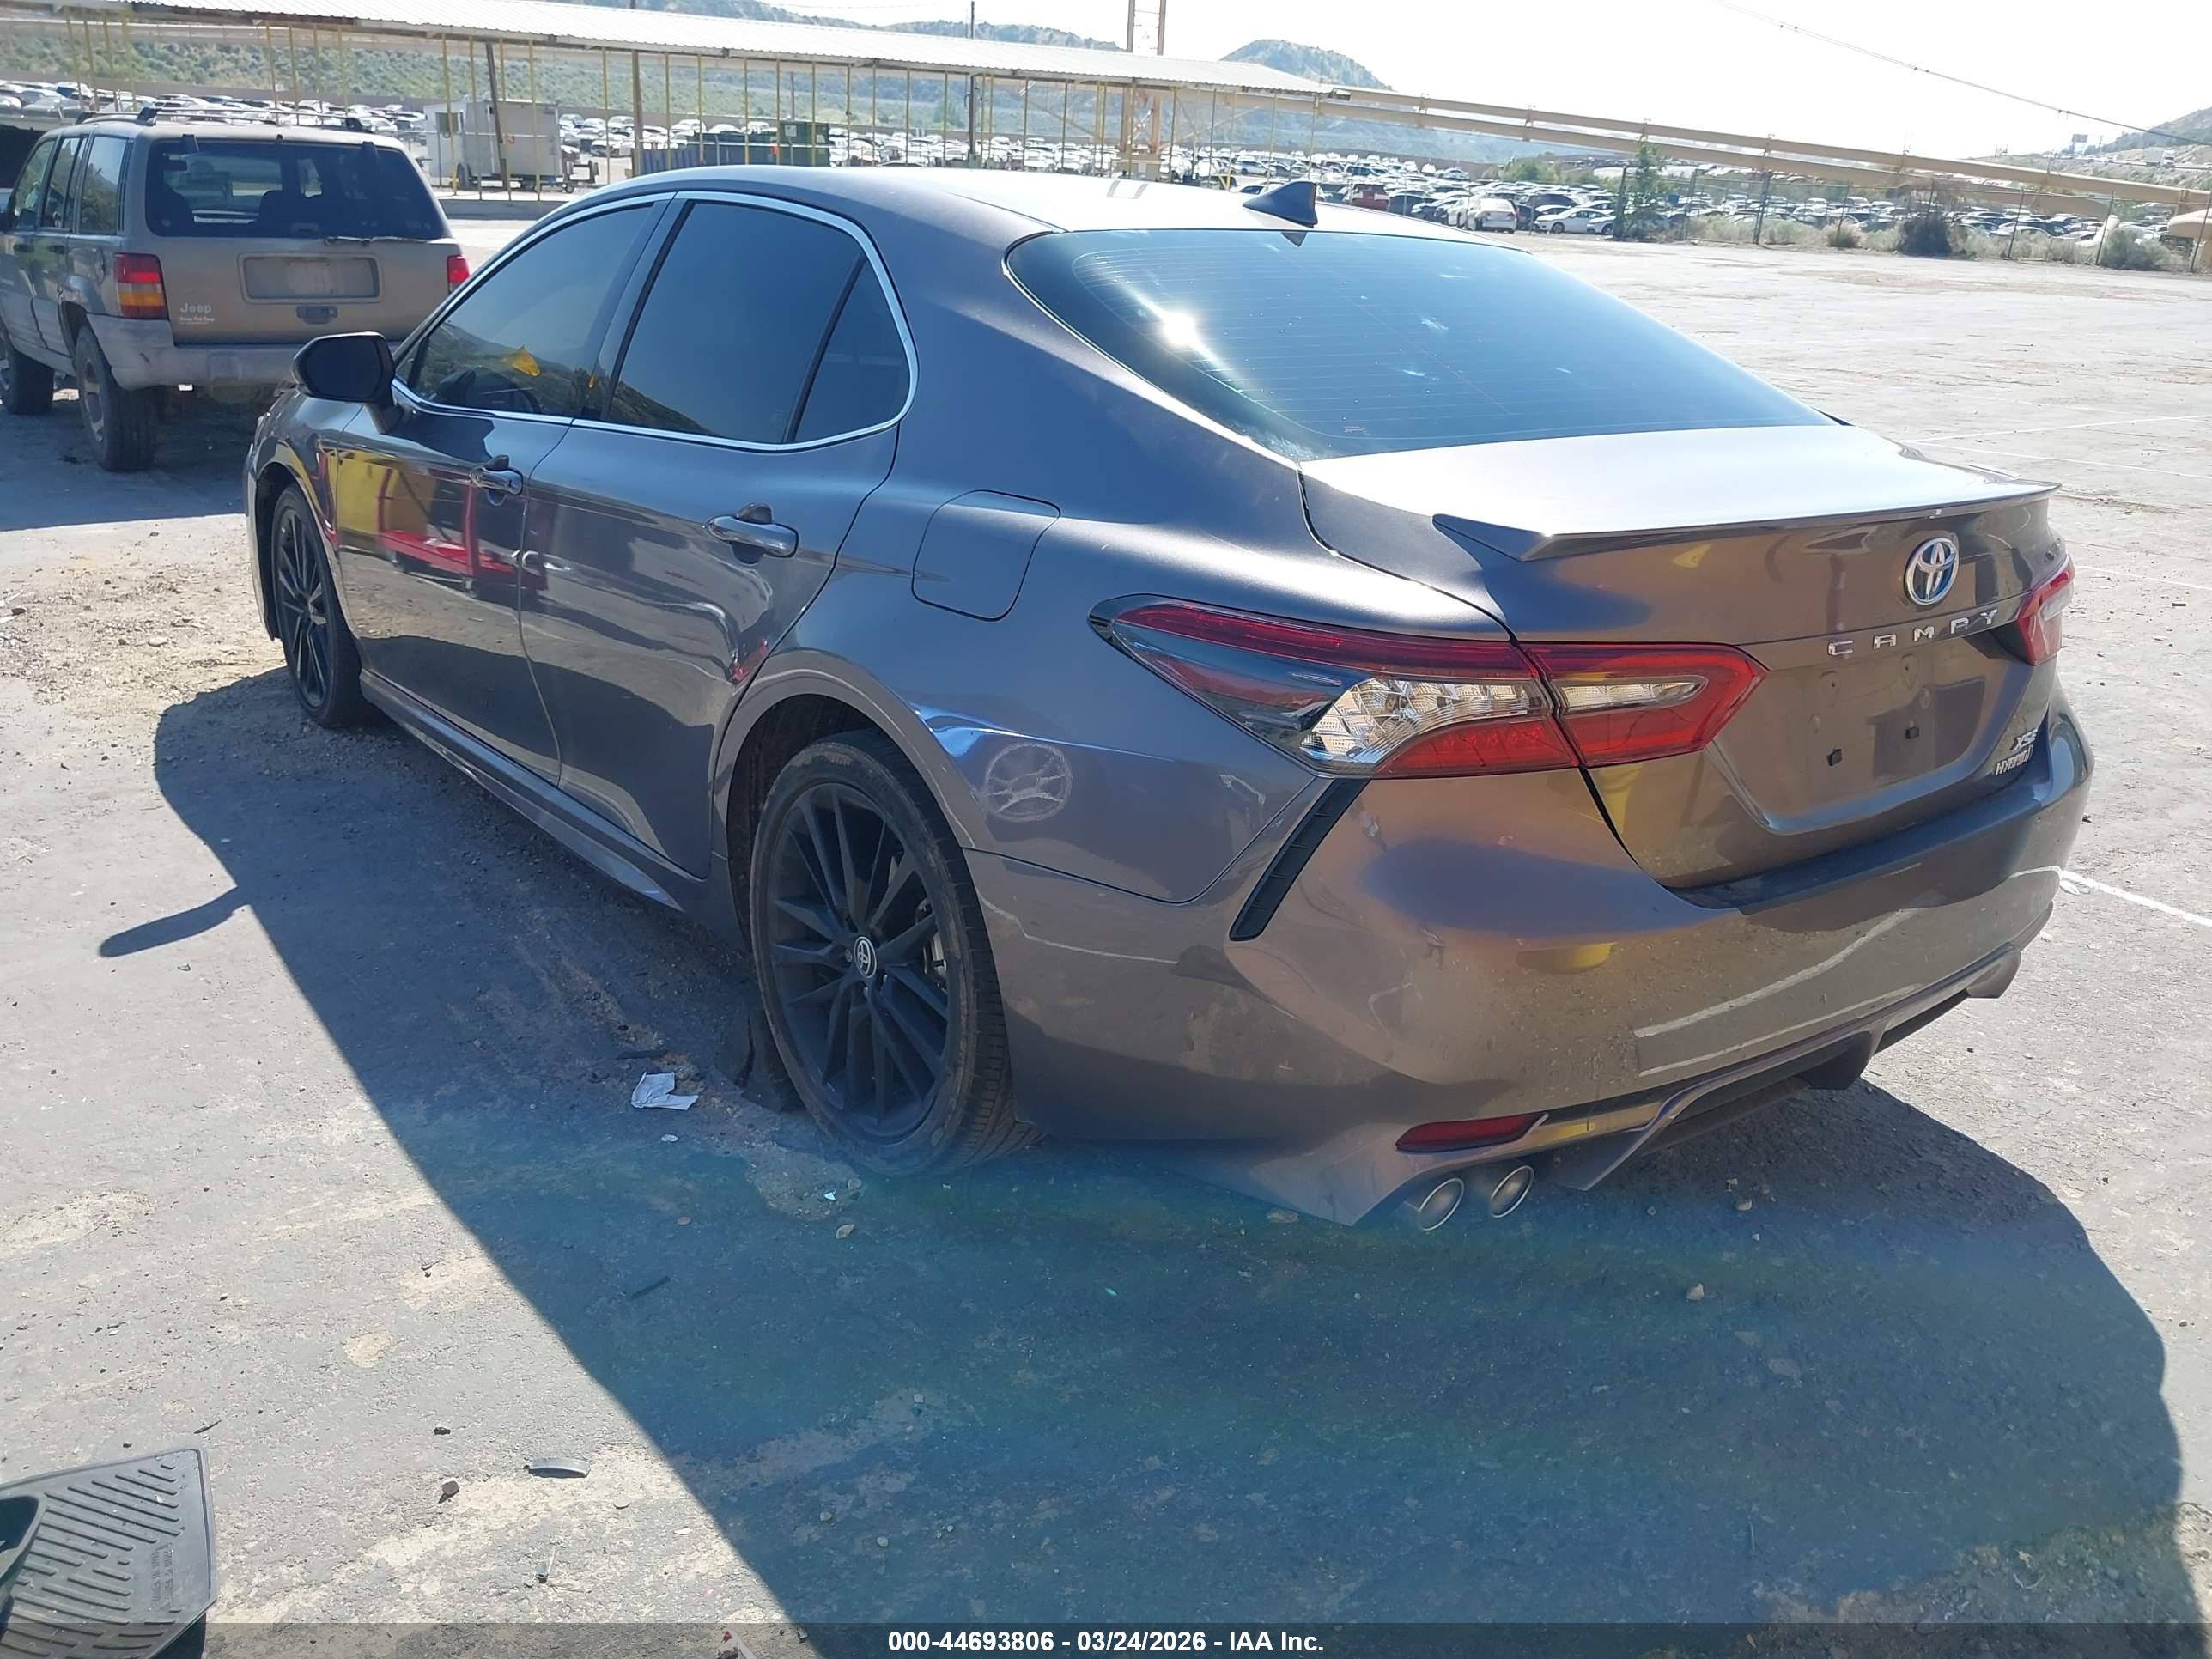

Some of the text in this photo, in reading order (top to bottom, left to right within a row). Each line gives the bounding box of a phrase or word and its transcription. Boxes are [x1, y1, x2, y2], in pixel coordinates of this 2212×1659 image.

[179, 302, 213, 315] Jeep
[1827, 608, 1999, 656] CAMRY
[2010, 728, 2039, 753] XSE
